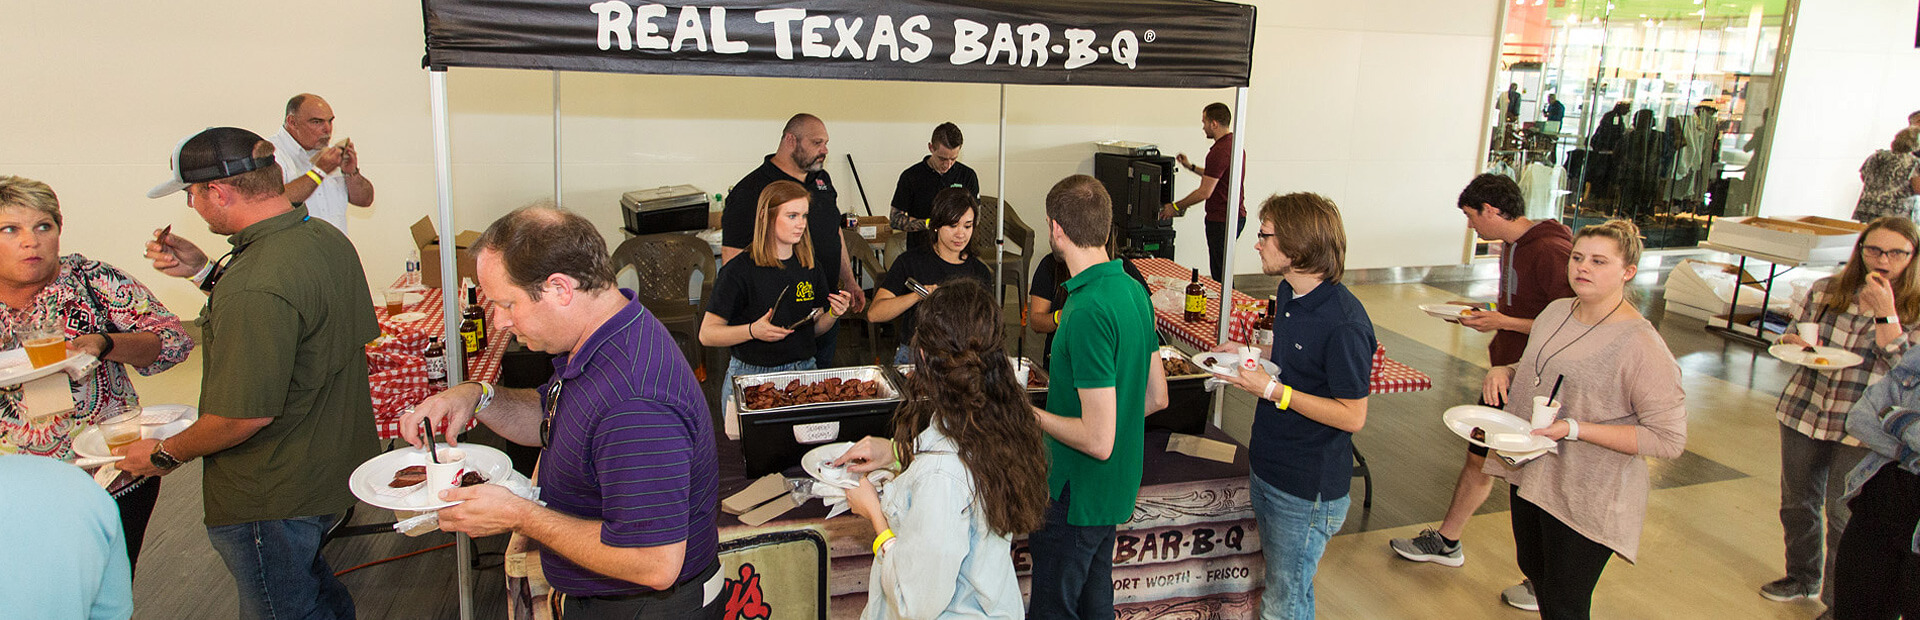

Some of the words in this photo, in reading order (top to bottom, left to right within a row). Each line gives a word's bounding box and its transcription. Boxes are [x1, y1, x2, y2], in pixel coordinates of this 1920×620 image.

[590, 0, 749, 54] REAL
[755, 8, 933, 63] TEXAS
[1113, 577, 1141, 591] ORT
[1146, 570, 1191, 588] WORTH
[1206, 567, 1249, 583] FRISCO
